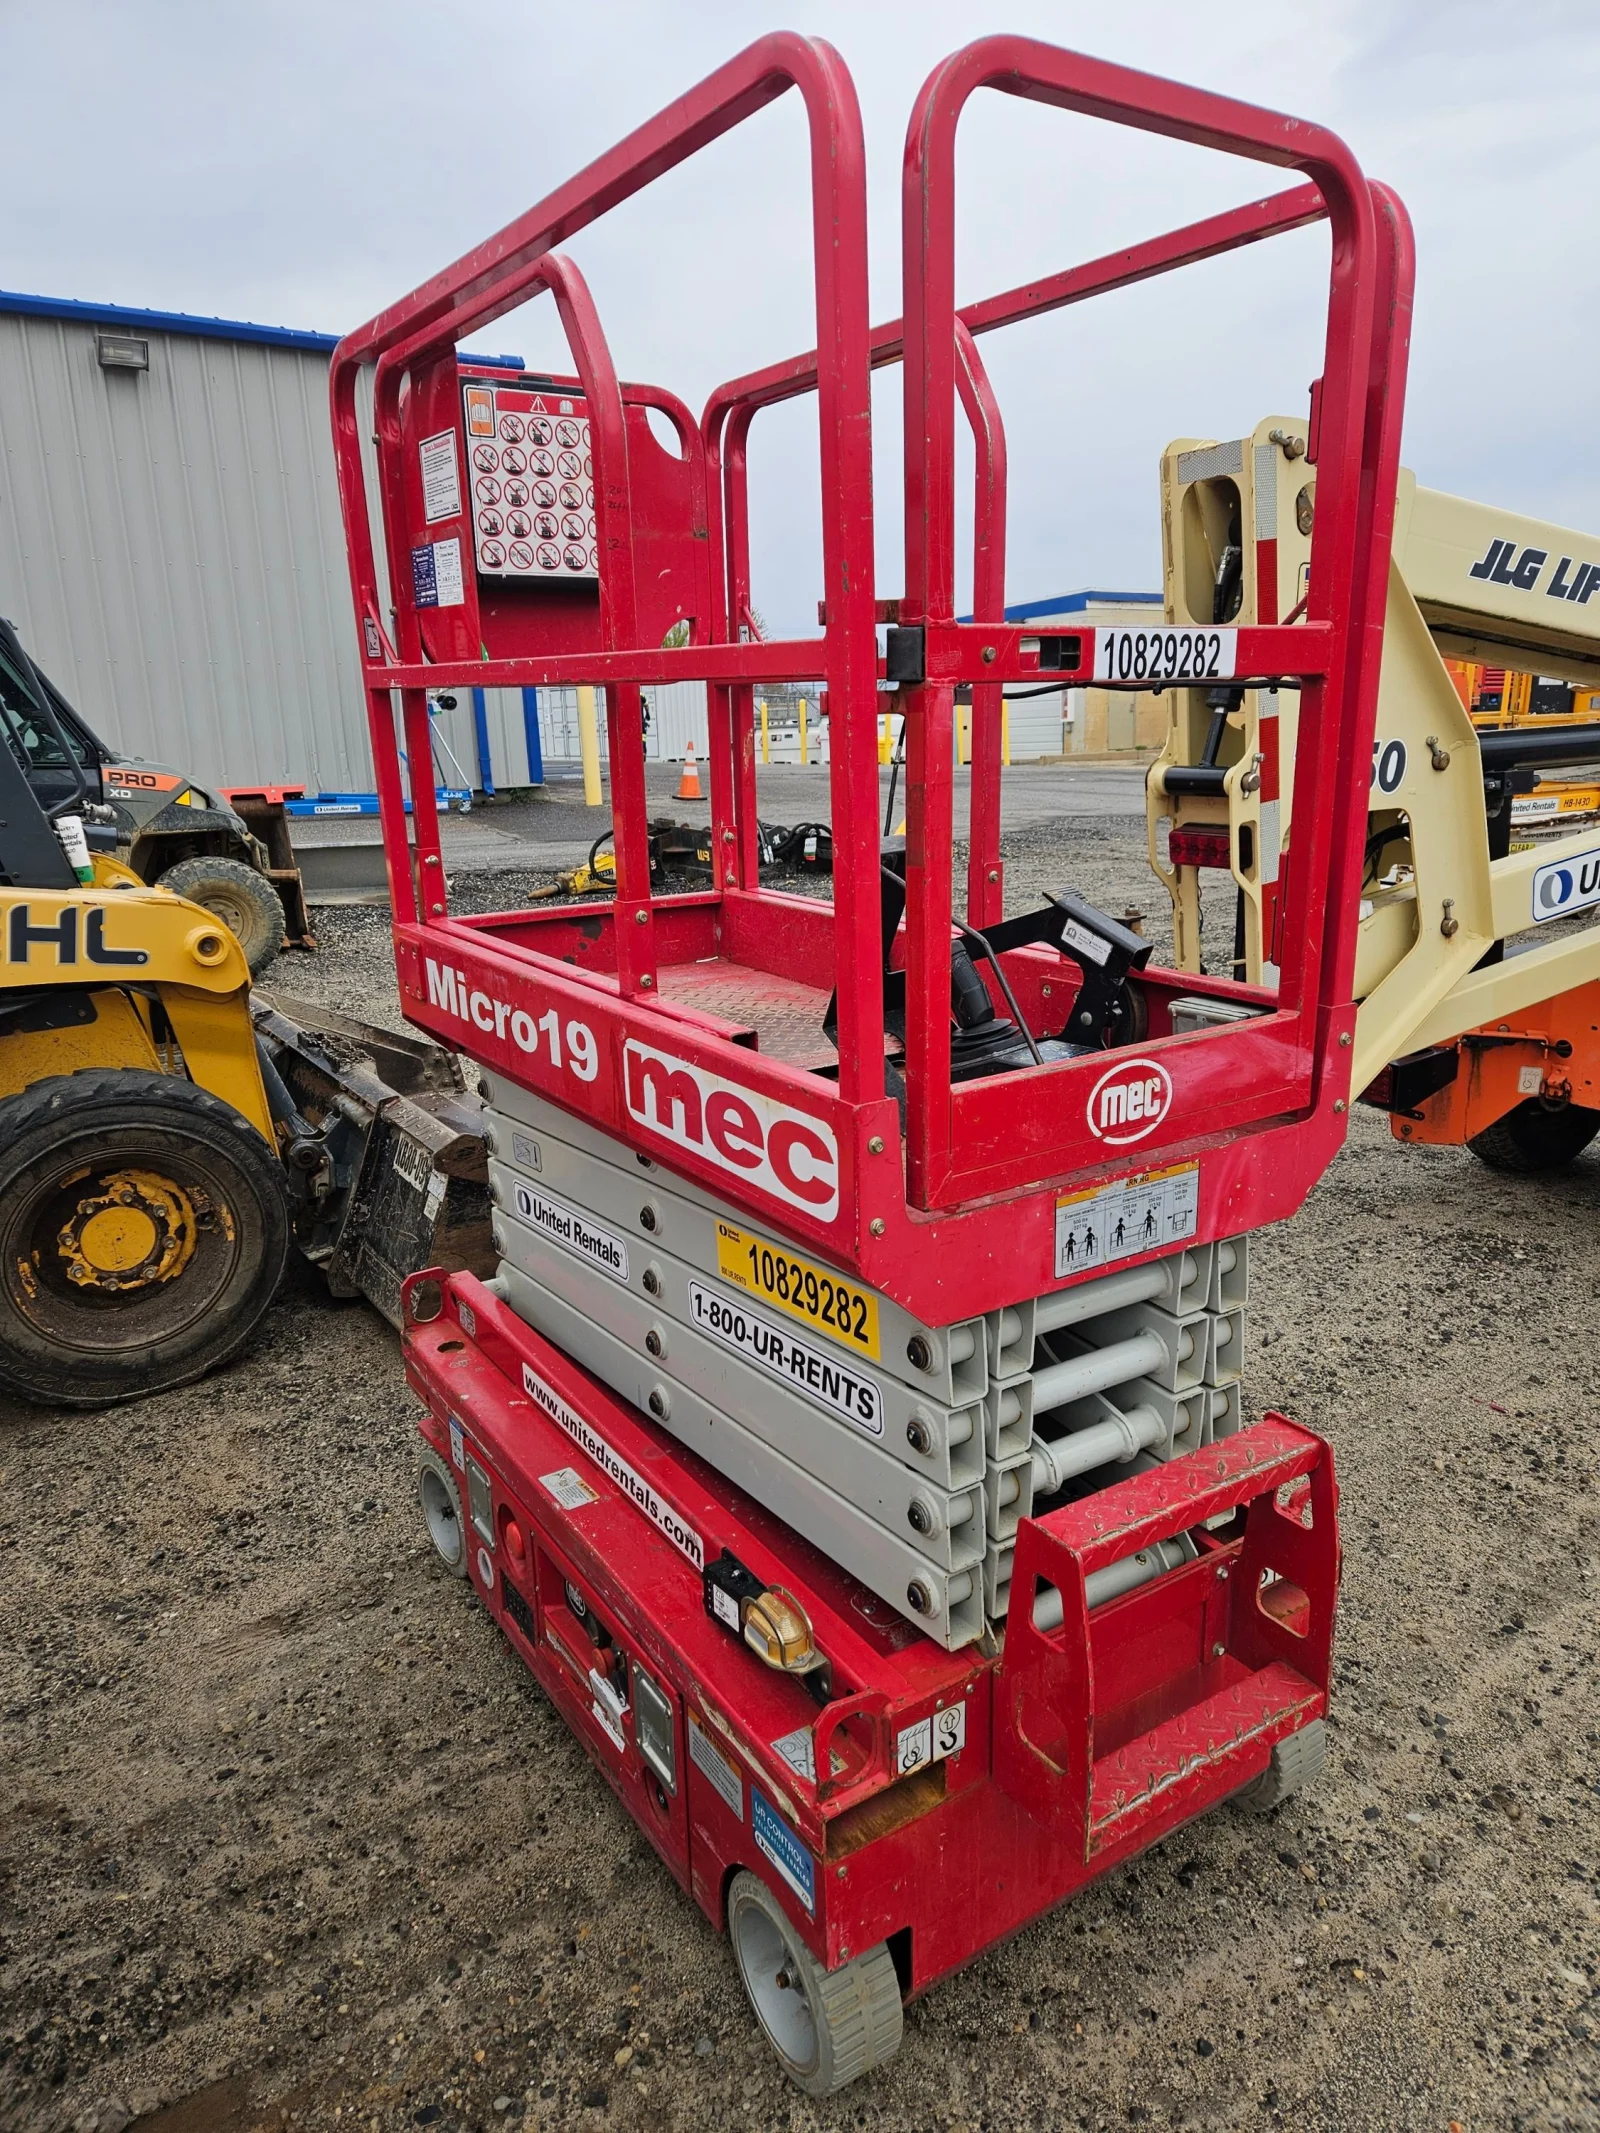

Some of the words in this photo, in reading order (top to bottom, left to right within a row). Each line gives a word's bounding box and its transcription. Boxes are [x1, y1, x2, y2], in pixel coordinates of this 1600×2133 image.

[1468, 539, 1548, 591] JLG
[1104, 632, 1221, 680] 10829282
[108, 771, 157, 788] PRO
[109, 788, 132, 798] XD
[1531, 801, 1557, 811] Rentals
[425, 957, 599, 1083] Micro19
[625, 1043, 838, 1206] mec
[1100, 1076, 1161, 1129] mec
[533, 1198, 571, 1239] United
[573, 1220, 621, 1268] Rentals
[748, 1243, 870, 1345] 10829282
[694, 1293, 875, 1421] 1-800-UR-RENTS
[524, 1372, 702, 1565] www.unitedrentals.com
[766, 1816, 805, 1869] CONTROL
